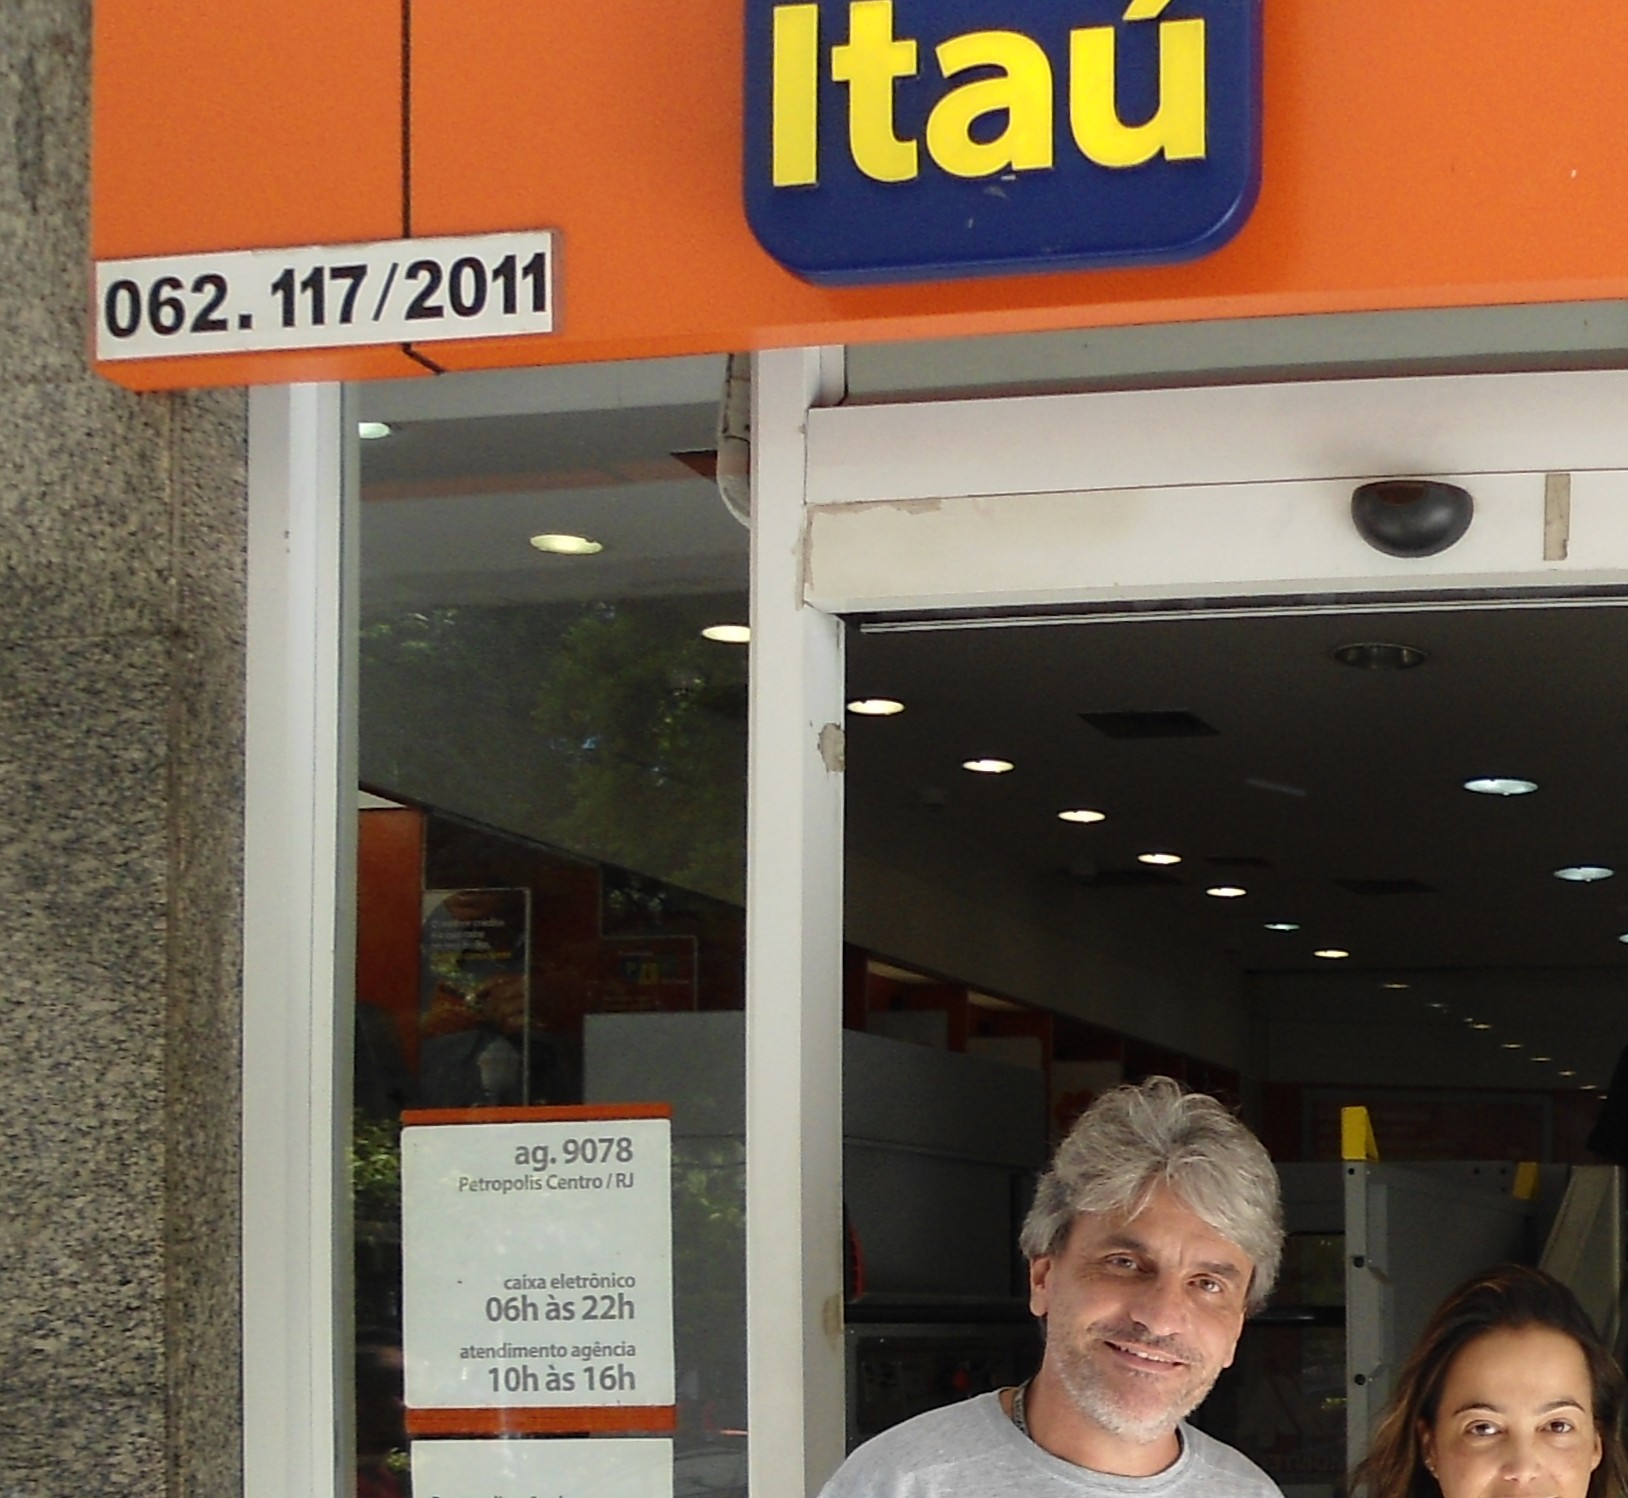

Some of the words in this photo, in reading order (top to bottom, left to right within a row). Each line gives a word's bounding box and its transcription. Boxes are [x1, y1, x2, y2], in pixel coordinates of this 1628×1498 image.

[772, 0, 1206, 187] Itaú
[514, 1144, 557, 1171] ag.
[563, 1136, 634, 1165] 9078
[458, 1174, 543, 1194] Petropolis
[546, 1173, 602, 1190] Centro
[616, 1172, 635, 1188] RJ
[504, 1274, 547, 1291] caixa
[550, 1272, 636, 1290] eletrônico
[485, 1294, 539, 1322] 06h
[545, 1293, 576, 1321] às
[581, 1292, 636, 1320] 22h
[459, 1342, 568, 1360] atendimento
[571, 1340, 636, 1361] agência
[488, 1364, 539, 1392] 10h
[545, 1364, 576, 1392] às
[583, 1362, 636, 1392] 16h
